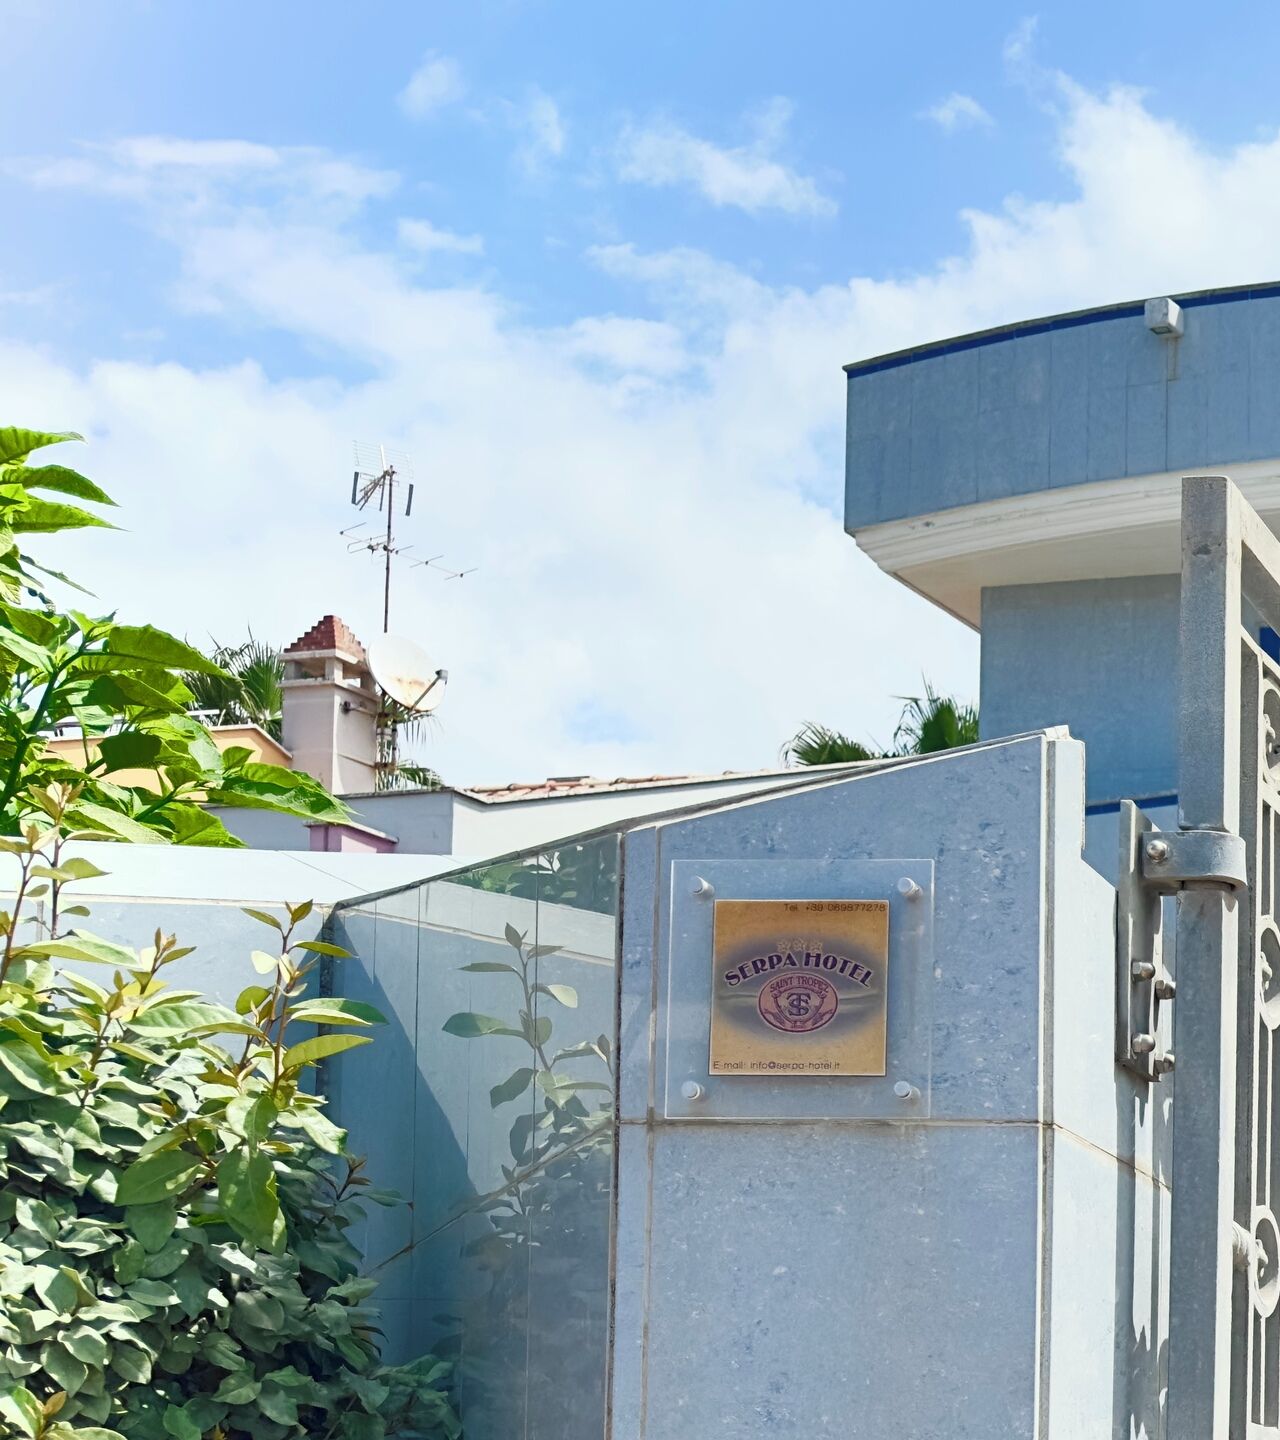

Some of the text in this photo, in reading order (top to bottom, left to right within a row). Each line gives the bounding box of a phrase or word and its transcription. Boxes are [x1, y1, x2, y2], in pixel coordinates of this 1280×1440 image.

[806, 903, 824, 912] +39
[725, 951, 874, 988] SERPA HOTEL
[769, 975, 829, 993] SAINT TROPEZ
